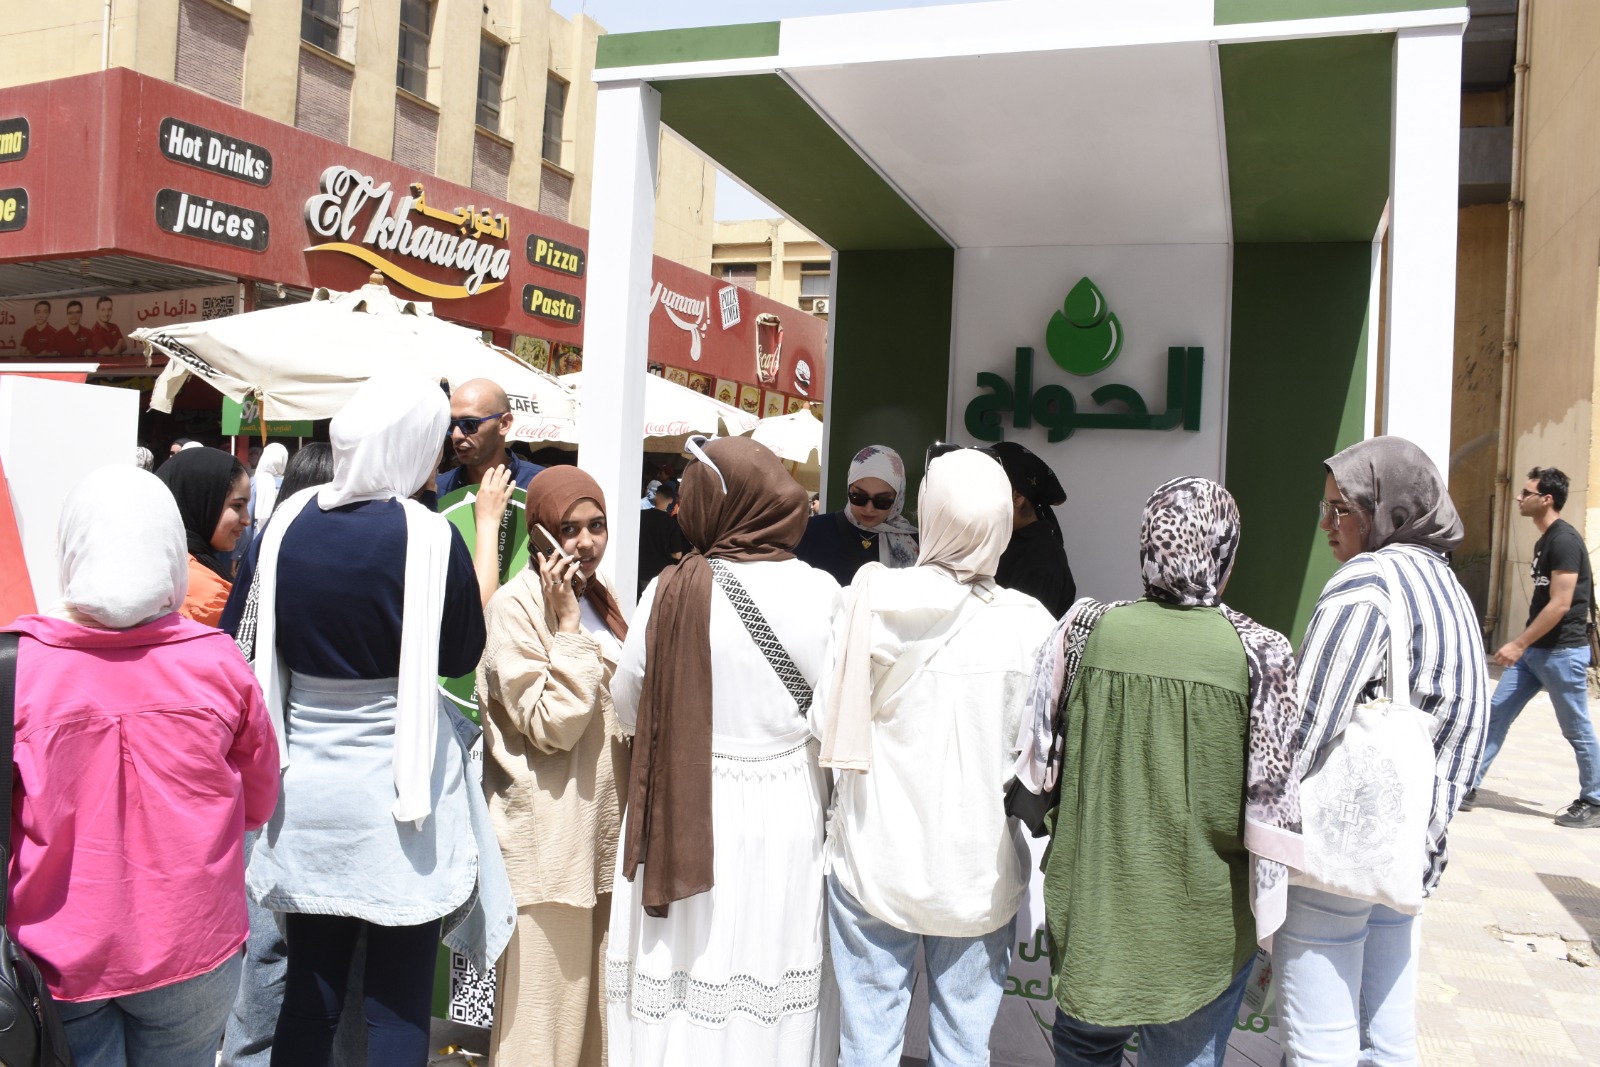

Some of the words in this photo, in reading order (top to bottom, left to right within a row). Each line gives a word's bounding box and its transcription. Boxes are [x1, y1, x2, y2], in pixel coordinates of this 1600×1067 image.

[168, 124, 203, 162] Hot
[207, 137, 265, 180] Drinks
[173, 193, 255, 241] Juices
[535, 239, 579, 273] Pizza
[163, 298, 197, 318] دائما
[531, 289, 575, 320] Pasta
[964, 346, 1204, 443] الحواج
[501, 509, 512, 529] Buy
[499, 531, 507, 551] one
